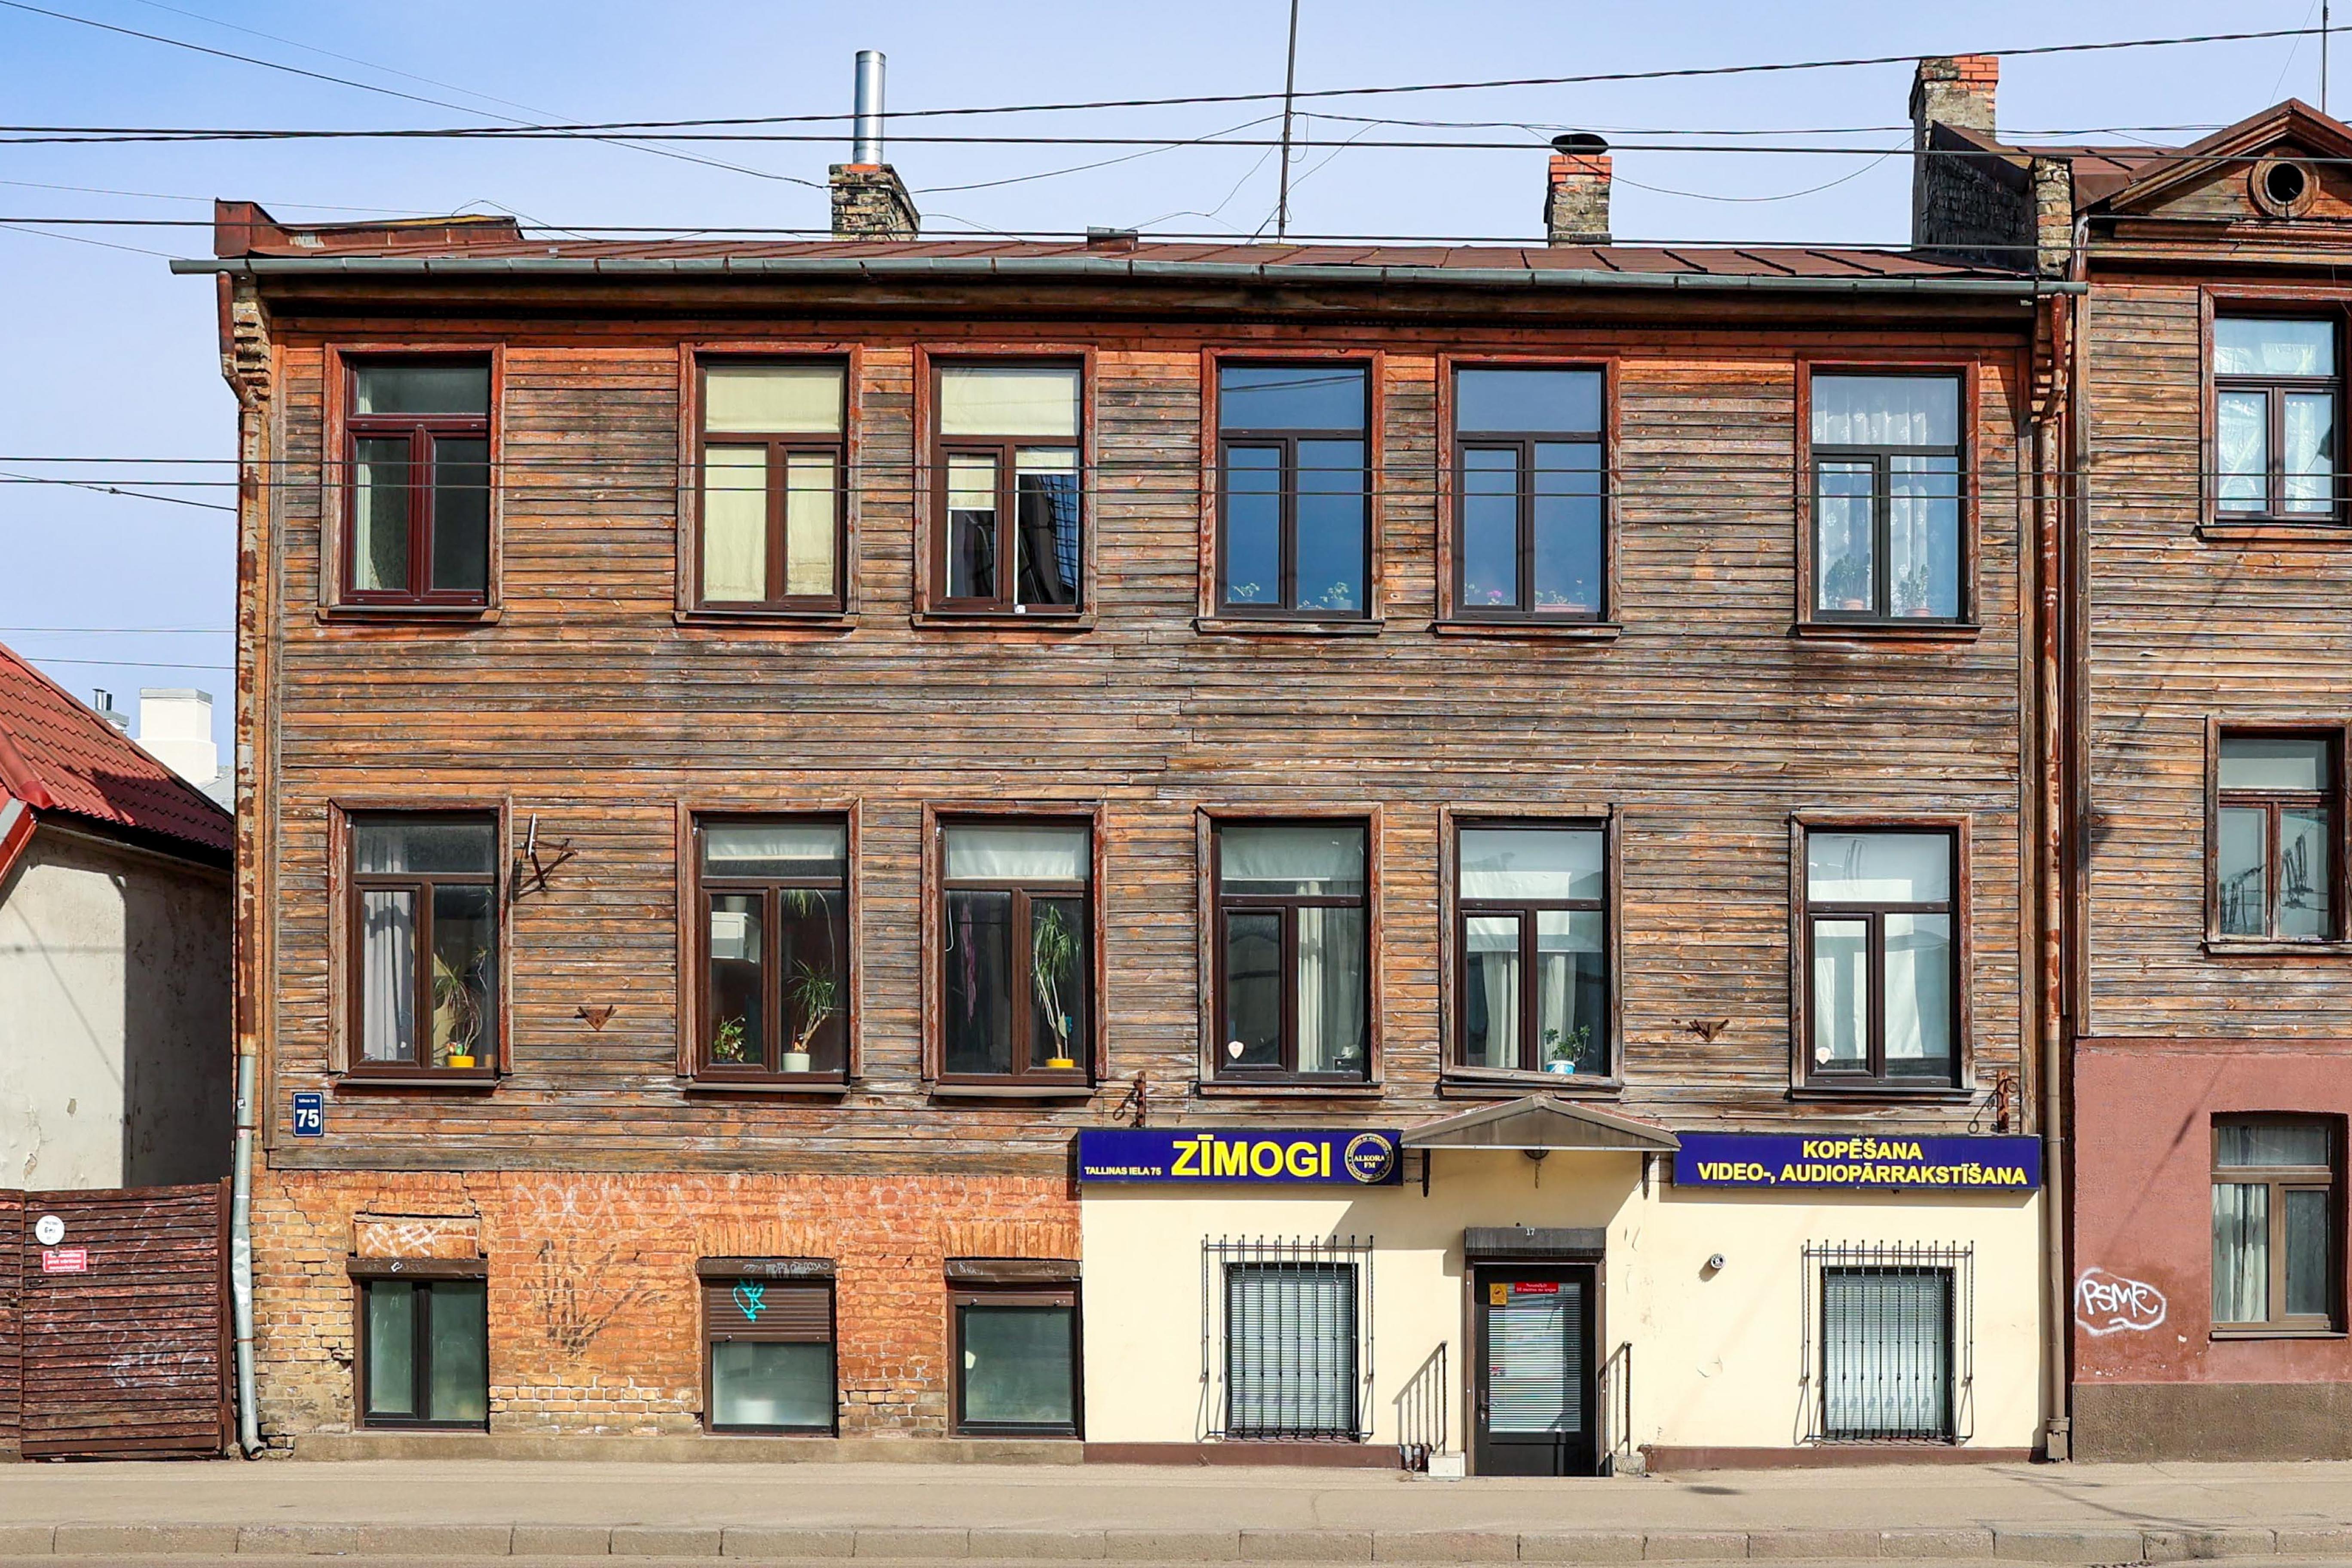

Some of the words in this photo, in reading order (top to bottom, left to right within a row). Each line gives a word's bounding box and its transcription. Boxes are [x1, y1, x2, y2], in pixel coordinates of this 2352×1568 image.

[296, 1109, 319, 1127] 75
[1171, 1134, 1331, 1177] ZĪMOGI
[1803, 1138, 1923, 1160] KOPĒŠANA
[1084, 1167, 1127, 1175] TALLINAS
[1129, 1167, 1150, 1176] IELA
[1150, 1167, 1161, 1176] 75
[1697, 1162, 1776, 1184] VIDEO-,
[1780, 1162, 2027, 1185] AUDIOPĀRRAKSTĪŠANA
